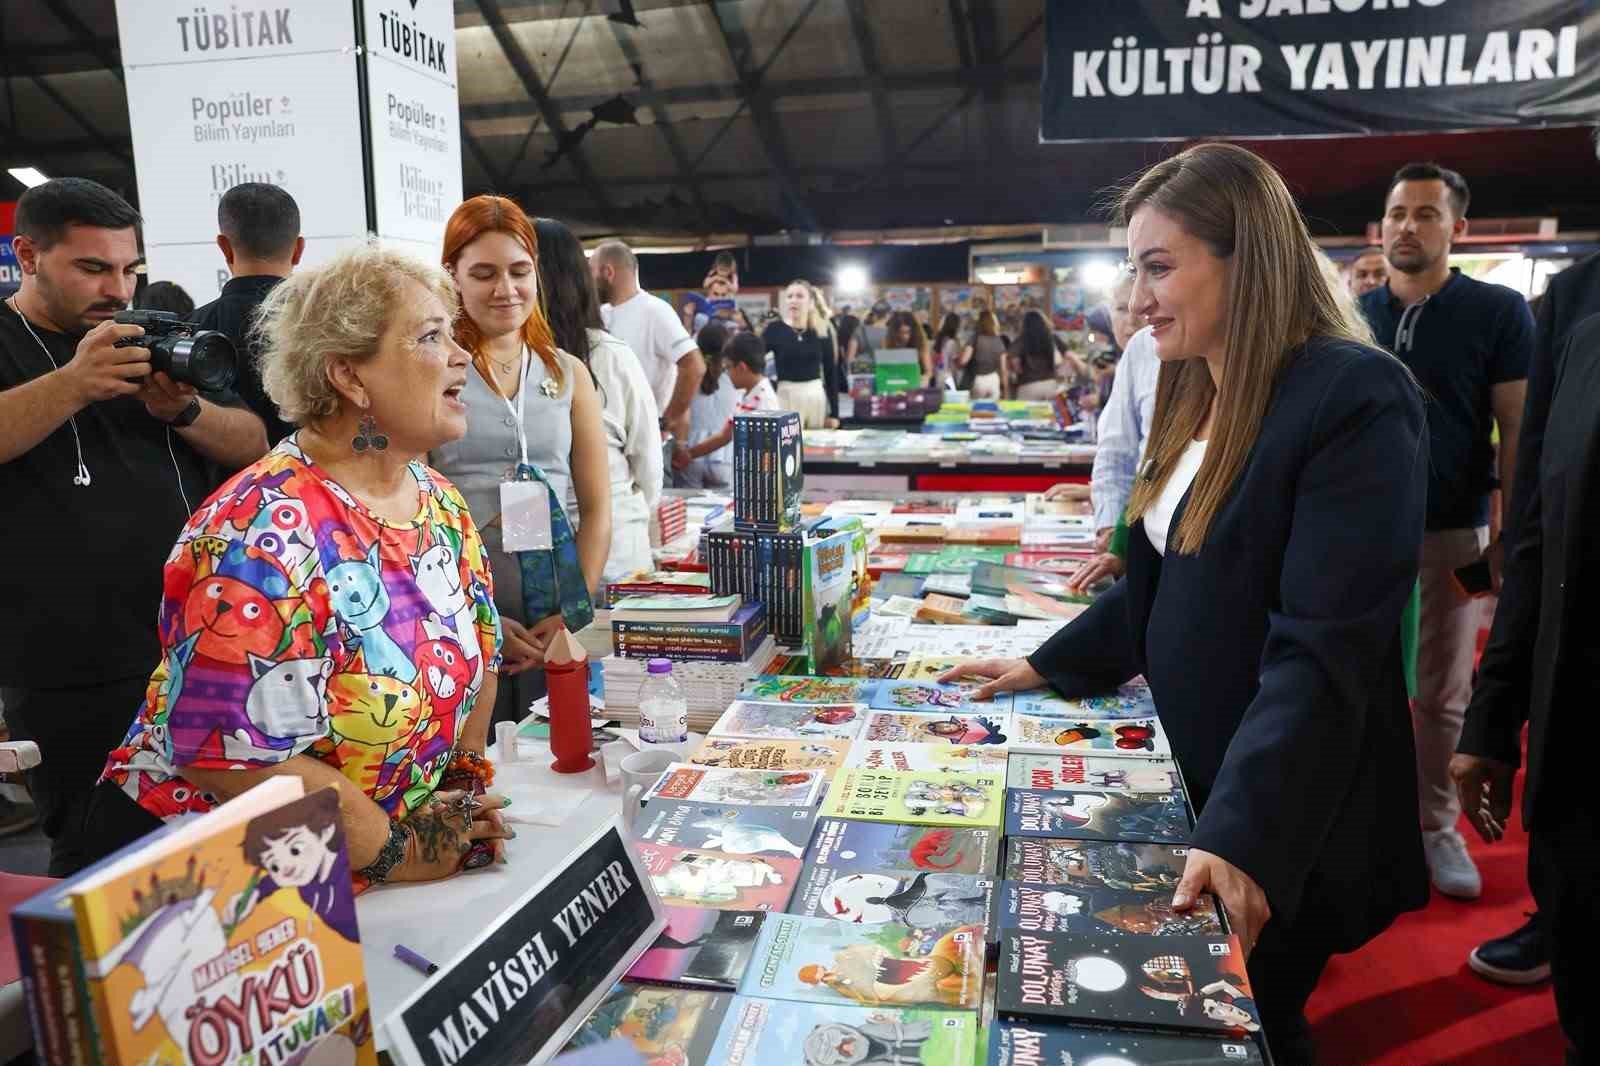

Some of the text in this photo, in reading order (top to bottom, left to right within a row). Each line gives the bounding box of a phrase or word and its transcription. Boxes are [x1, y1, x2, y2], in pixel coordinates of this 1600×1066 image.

[176, 5, 293, 52] TÜBİTAK
[379, 10, 447, 74] TÜBİTAK
[1072, 25, 1578, 97] KÜLTÜR YAYINLARI
[191, 92, 272, 126] Popüler
[388, 93, 436, 131] Popüler
[193, 120, 295, 144] Bilim Yayınları
[1020, 792, 1041, 831] DOLUNAY
[1022, 841, 1045, 884] DOLUNAY
[1019, 887, 1046, 930] OLUNAY
[428, 860, 632, 1066] MAVİSEL YENER
[1020, 935, 1053, 1005] DOLUNAY
[185, 943, 320, 1066] ÖYKÜ
